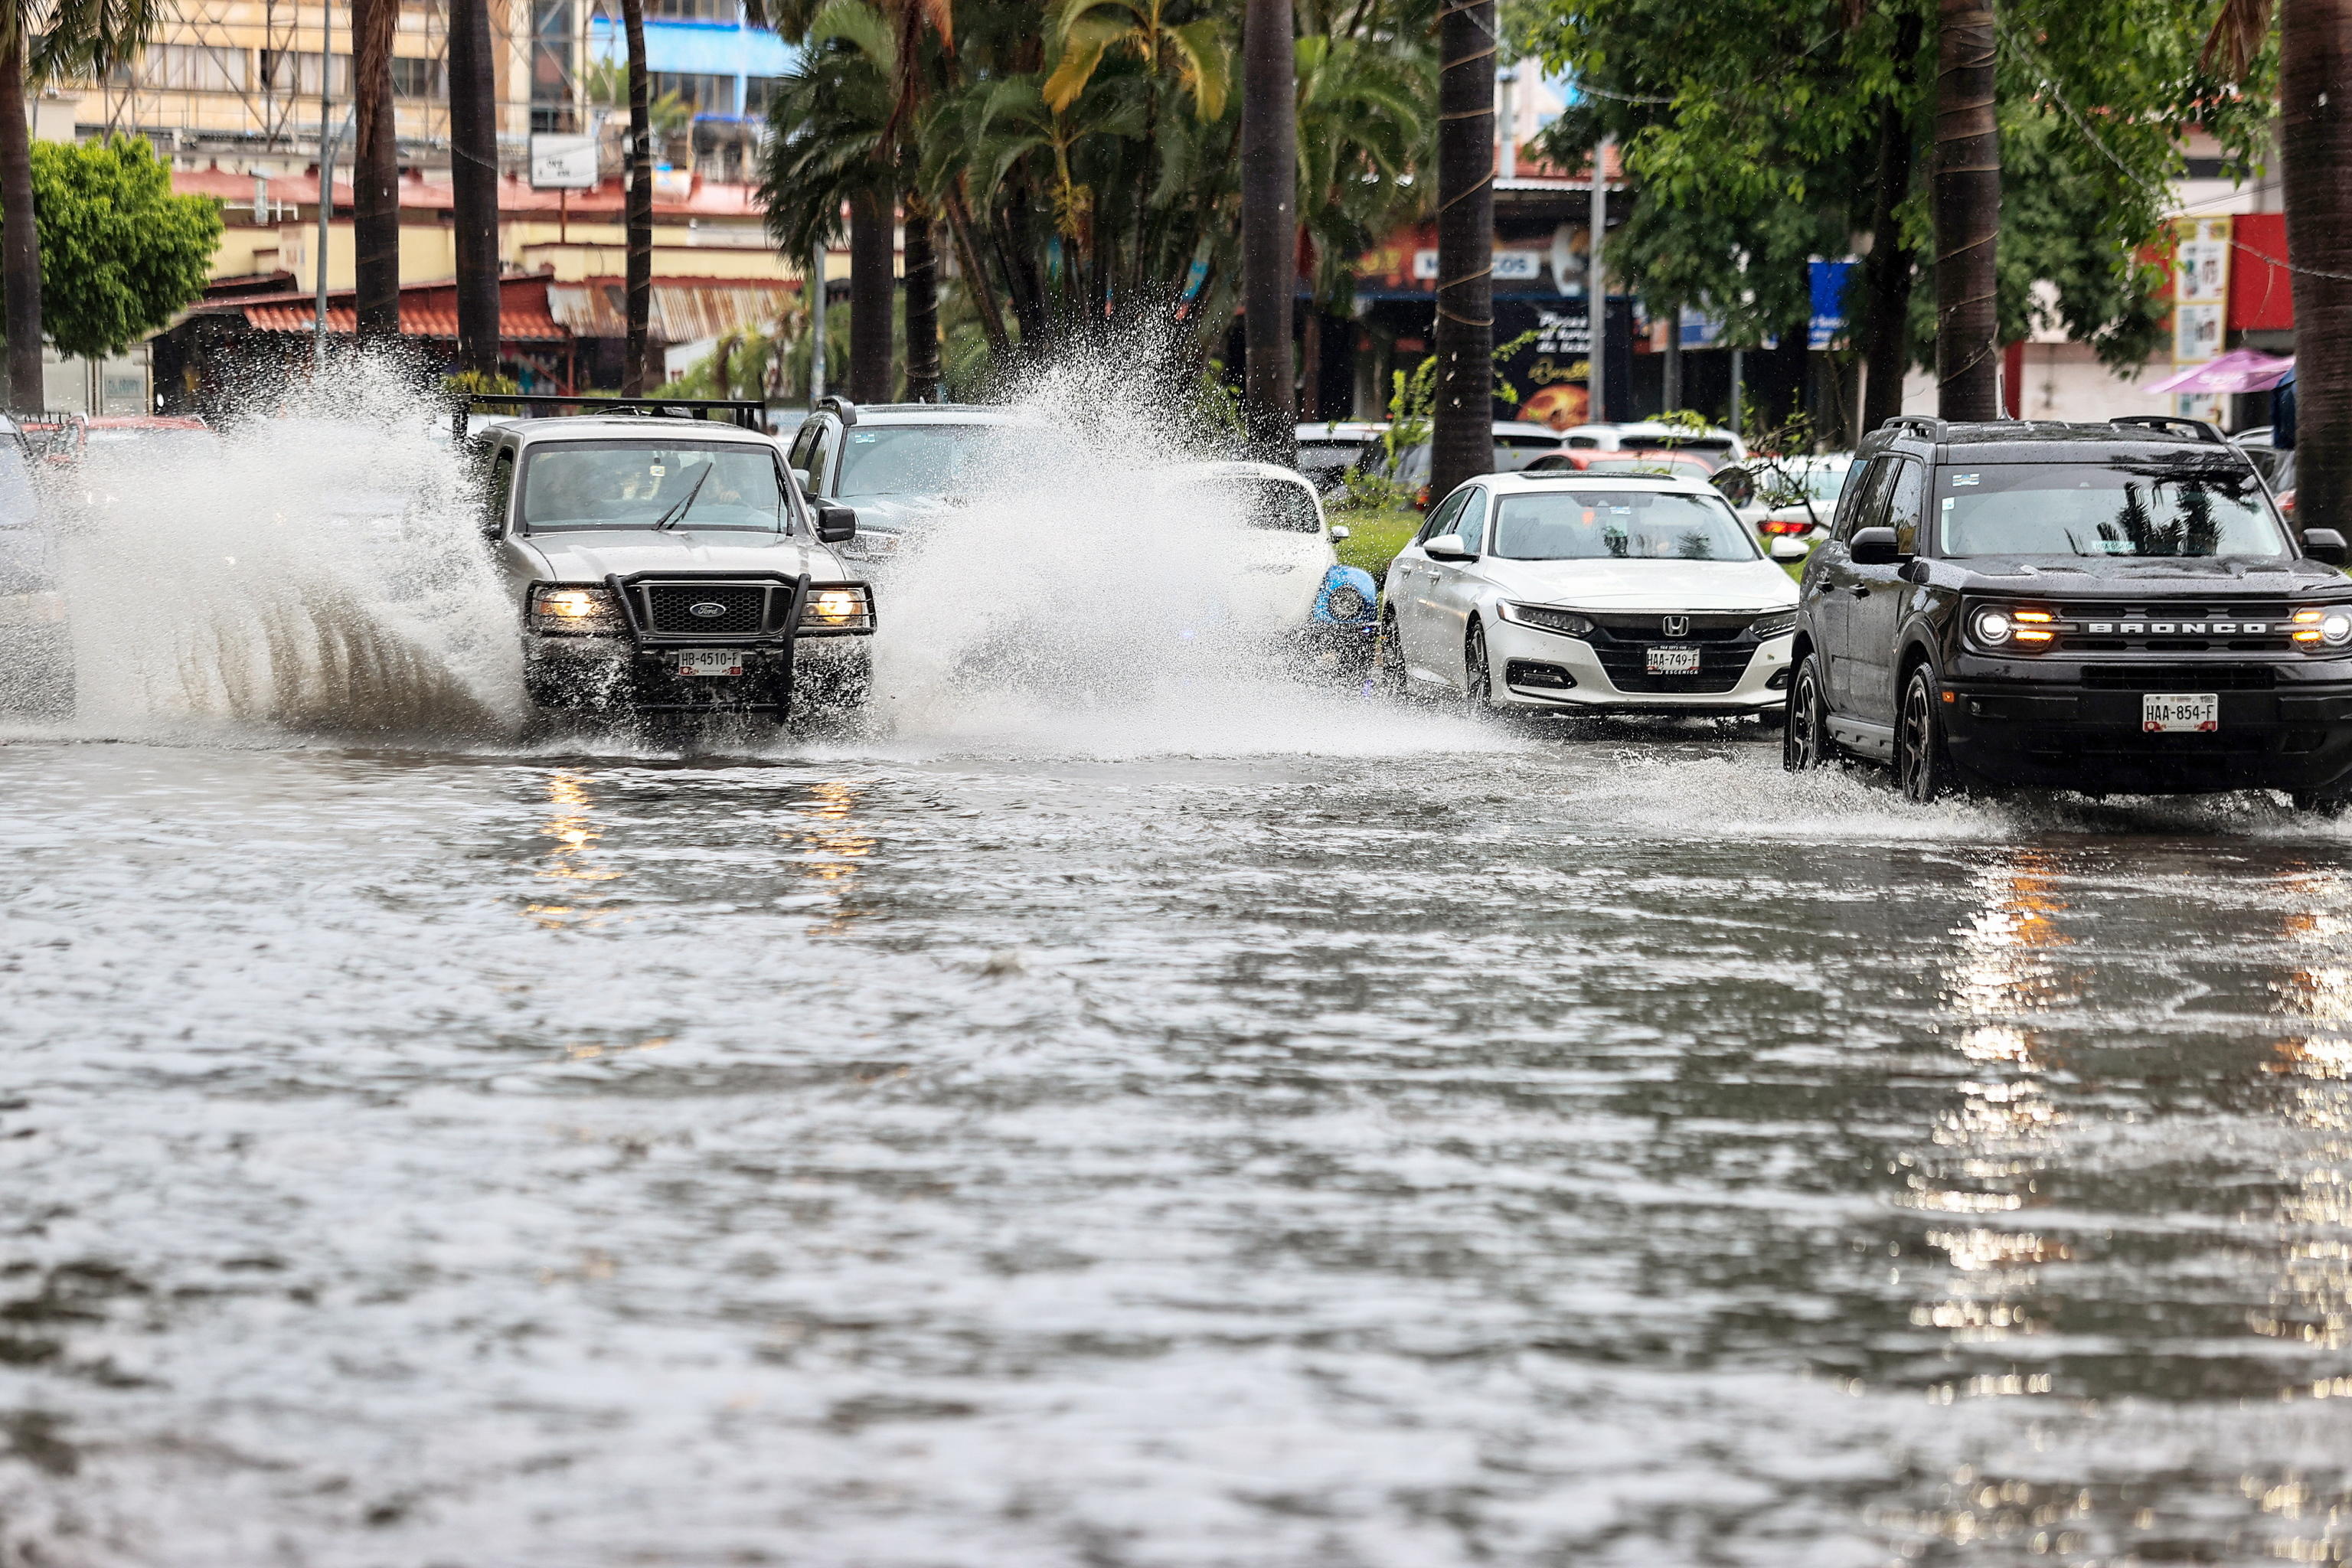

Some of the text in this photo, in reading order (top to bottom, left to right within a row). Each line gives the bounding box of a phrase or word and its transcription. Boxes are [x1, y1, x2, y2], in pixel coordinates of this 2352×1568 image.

[2089, 623, 2266, 634] BRONCO
[681, 652, 738, 665] HB-4510-F
[1647, 653, 1698, 665] HAA-749-F
[2146, 705, 2214, 720] HAA-854-F
